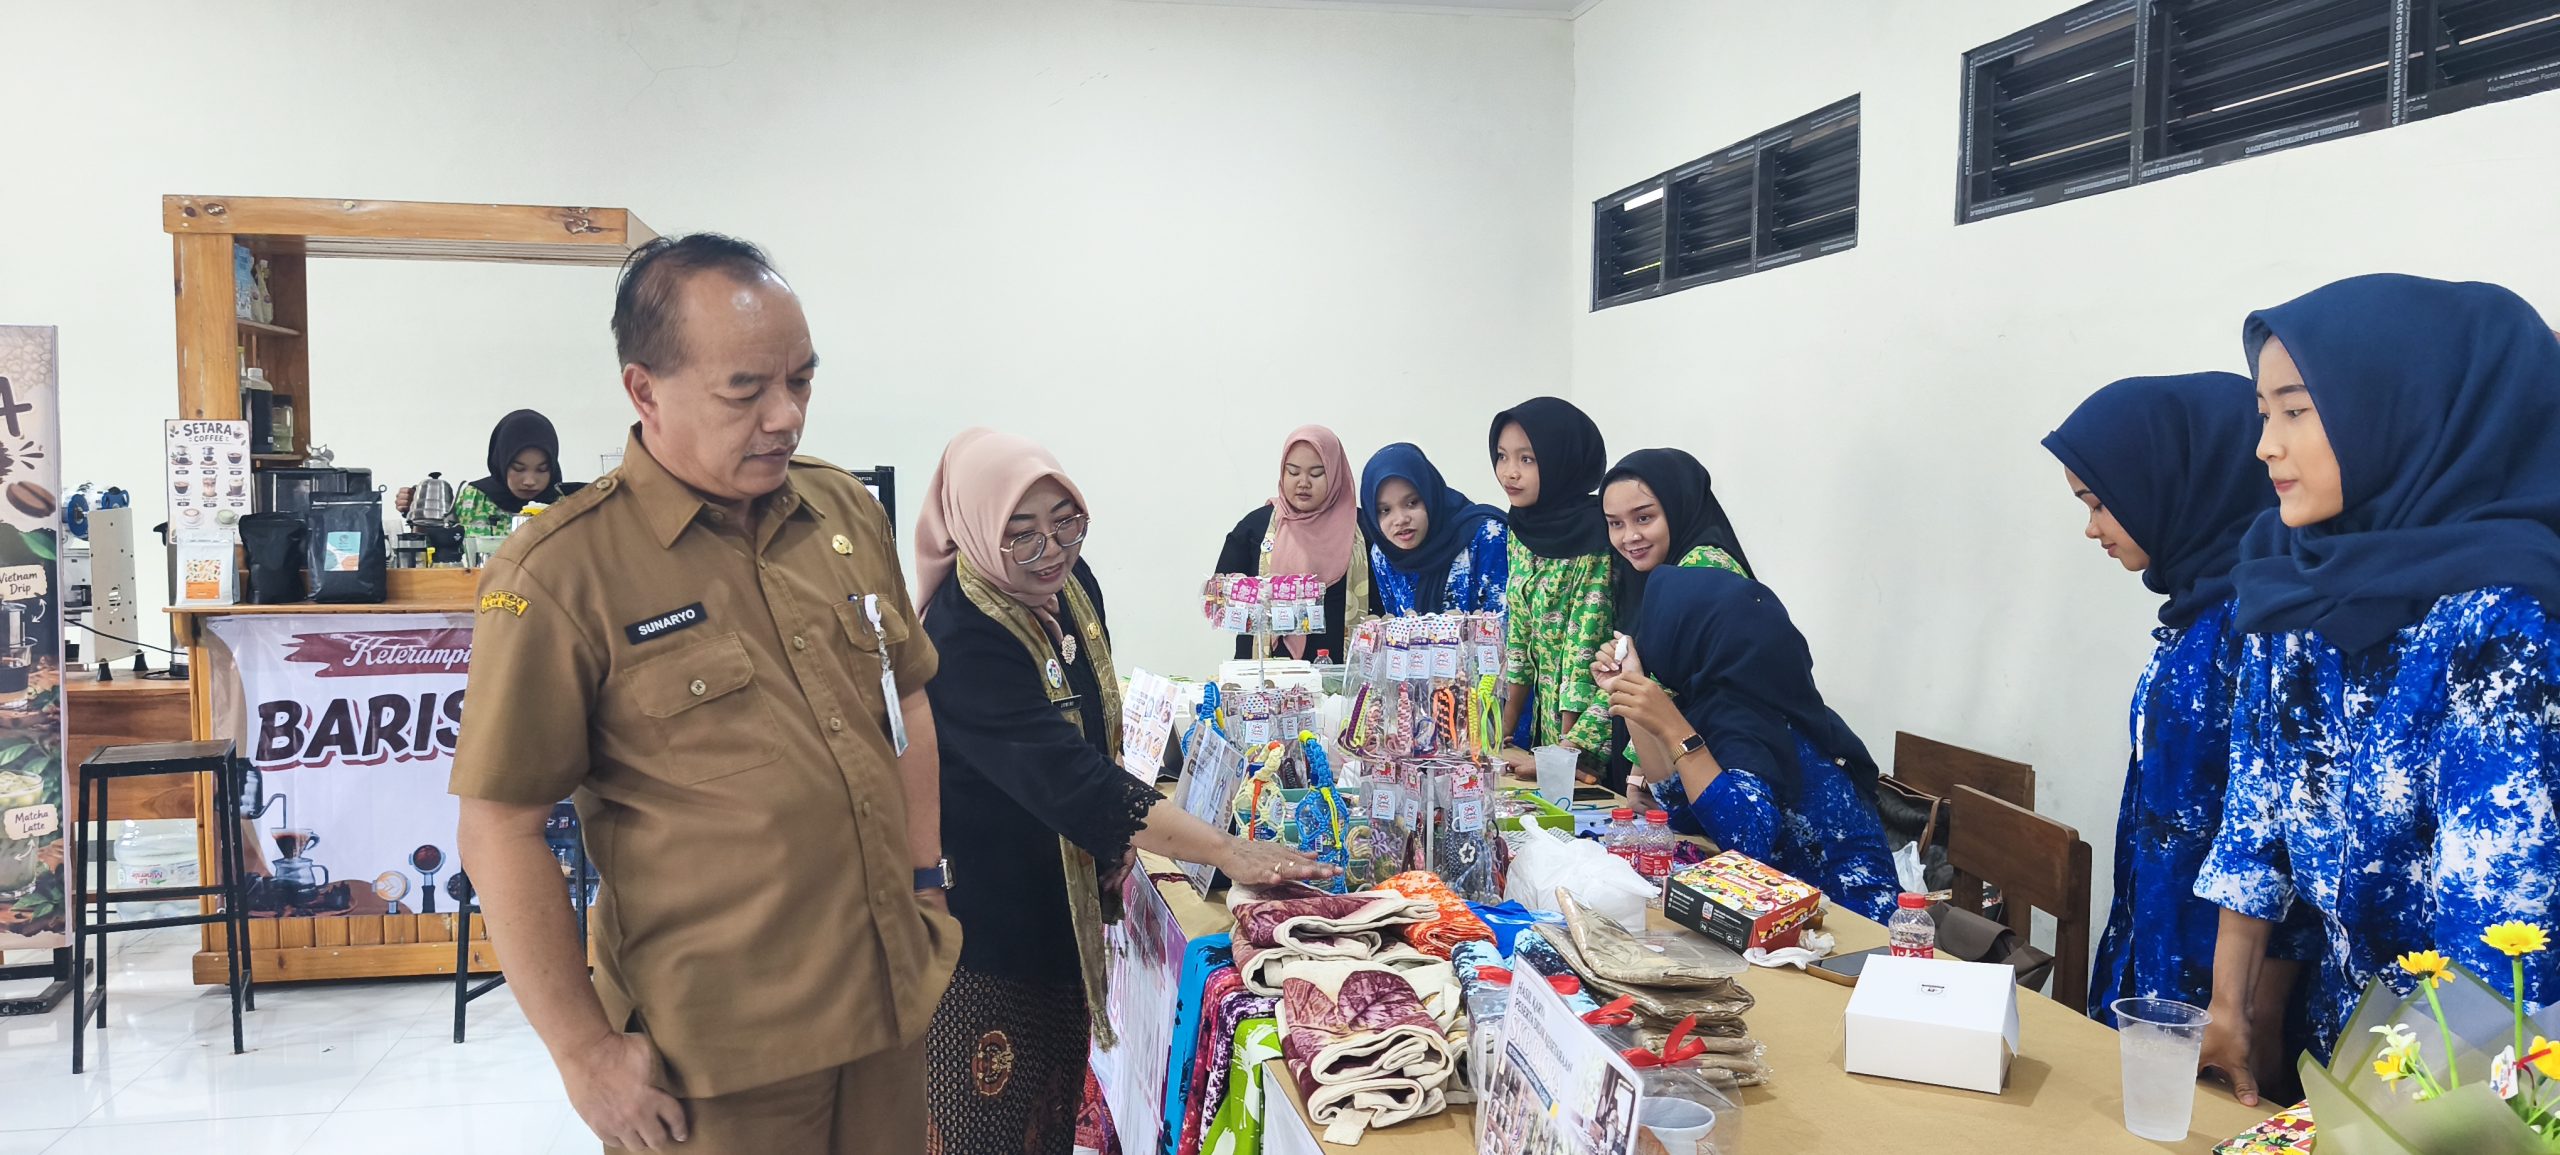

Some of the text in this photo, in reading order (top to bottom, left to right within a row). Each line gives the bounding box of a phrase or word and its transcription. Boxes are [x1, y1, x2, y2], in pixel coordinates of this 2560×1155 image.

[183, 422, 232, 437] SETARA
[194, 434, 224, 442] COFFEE
[0, 572, 38, 584] Vietnam
[10, 583, 31, 596] Drip
[638, 609, 696, 636] SUNARYO
[15, 810, 49, 824] Matcha
[23, 822, 45, 834] Latte
